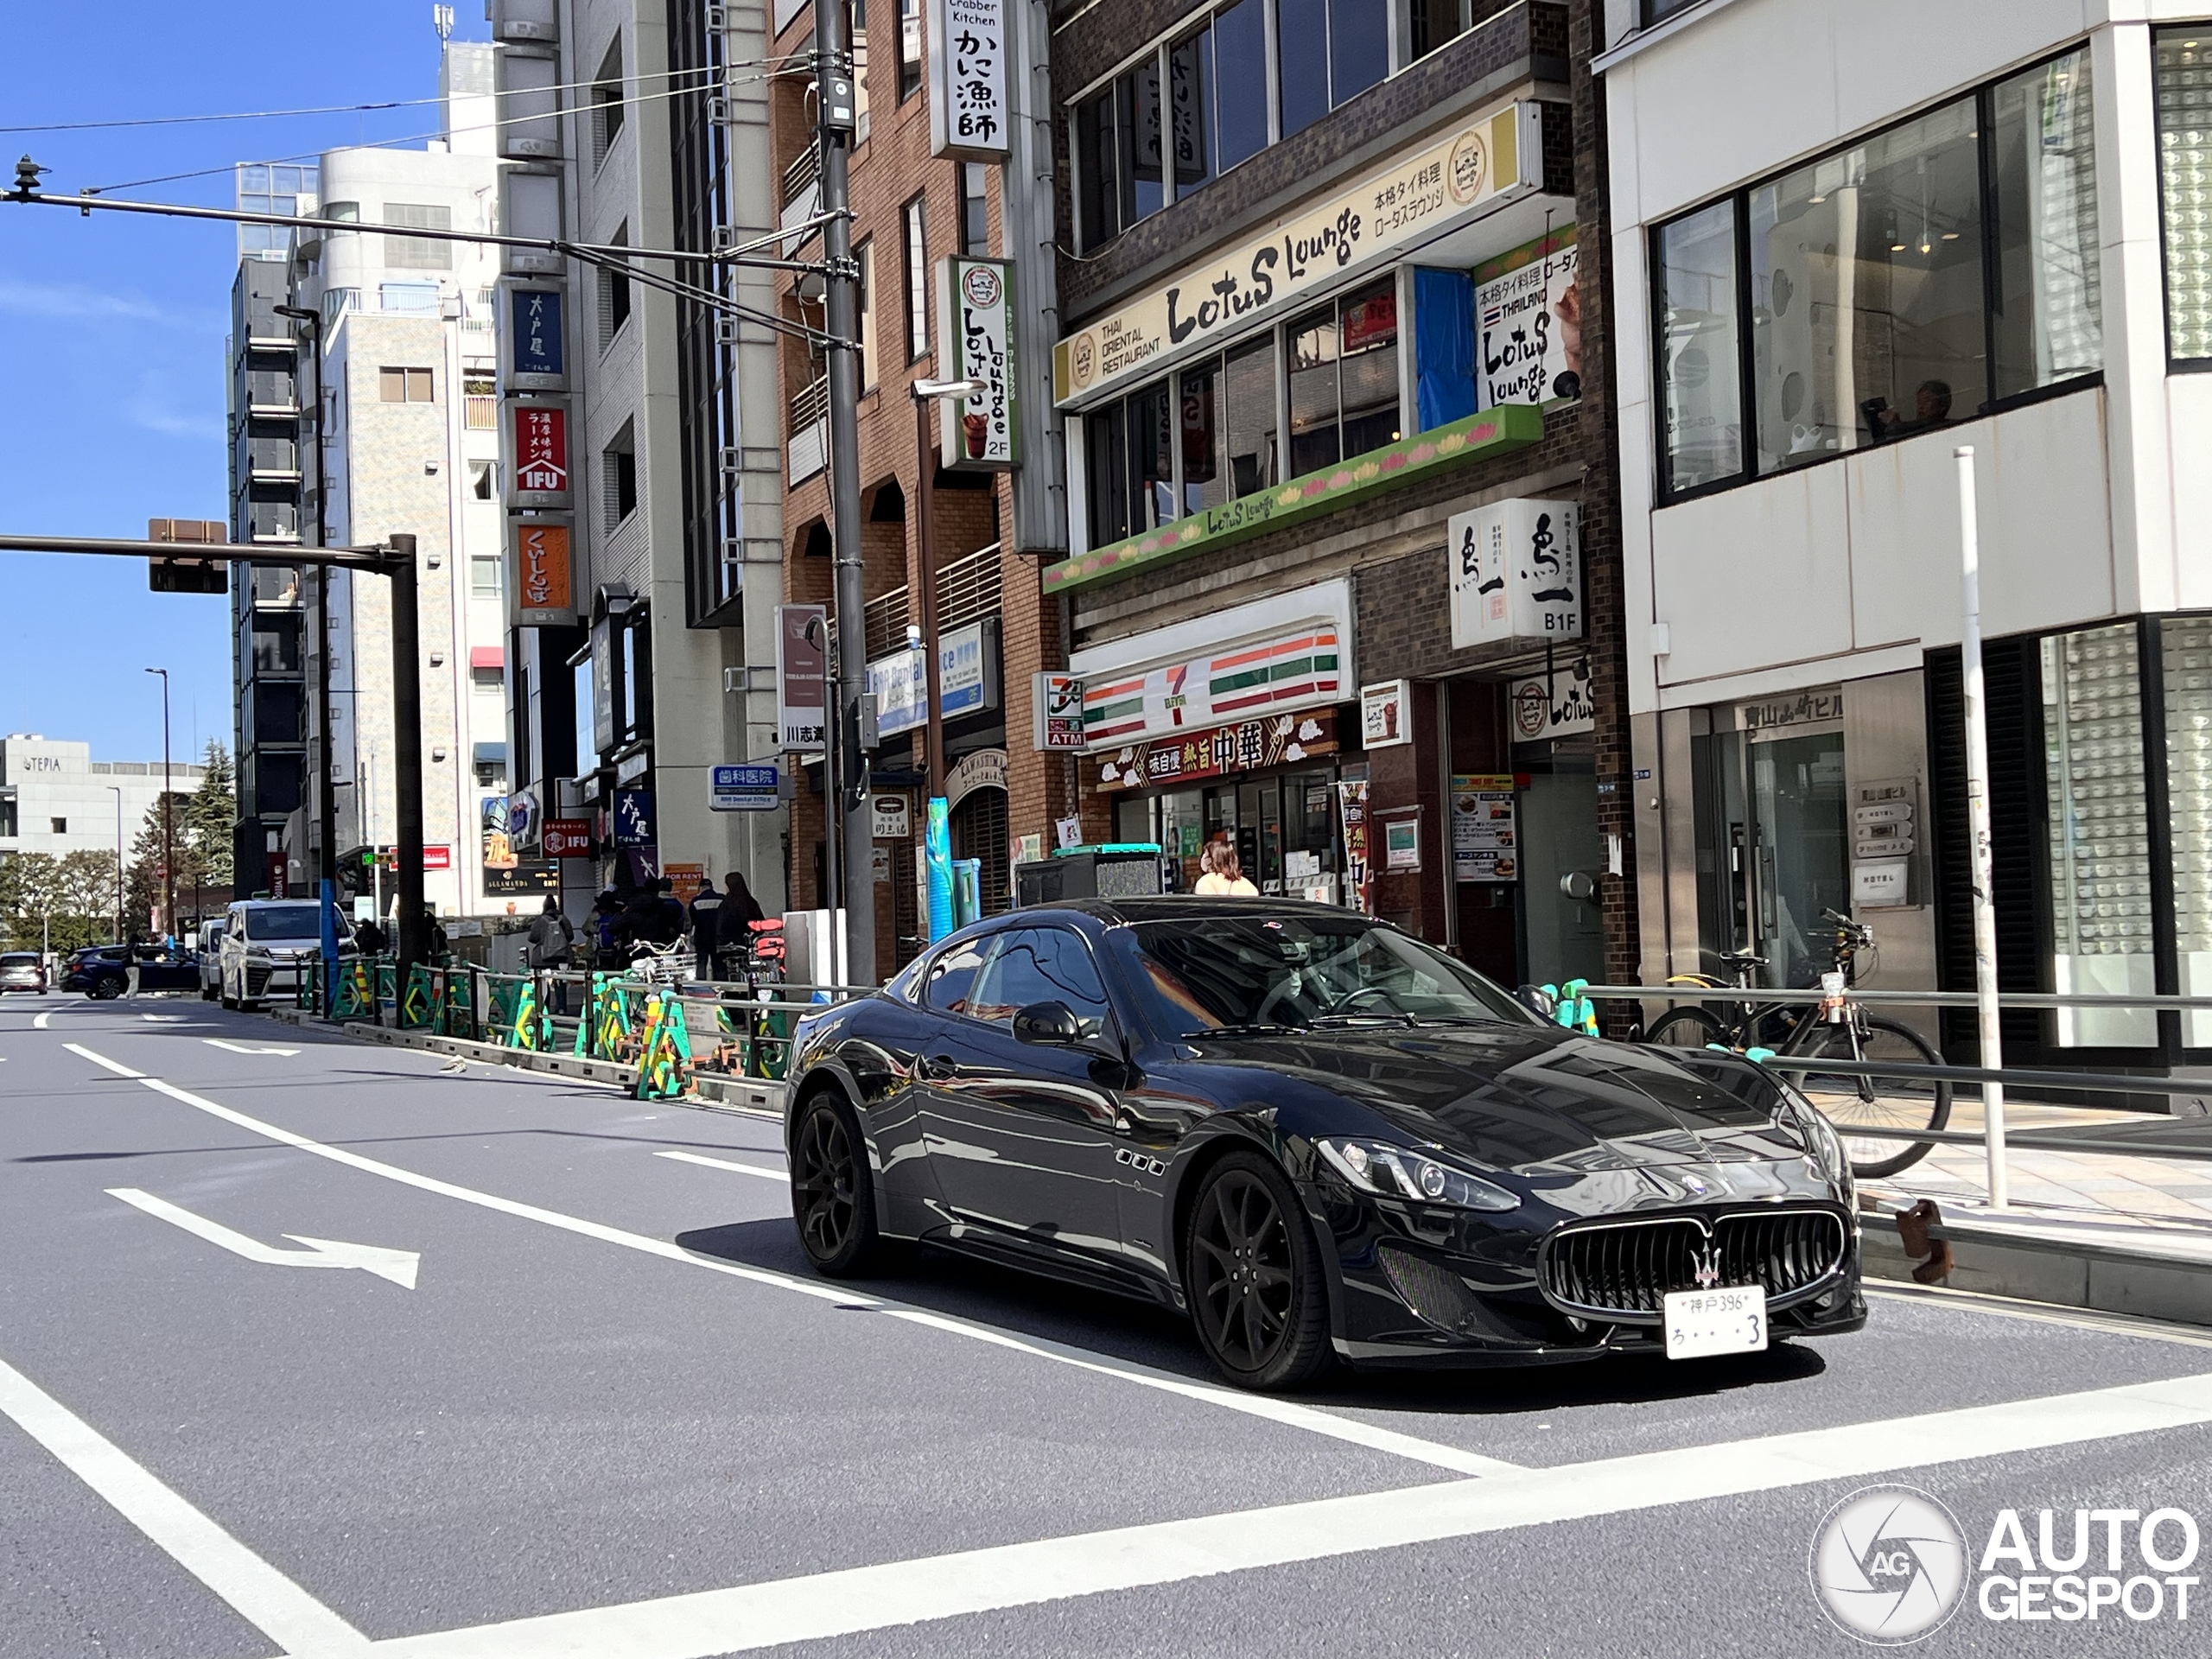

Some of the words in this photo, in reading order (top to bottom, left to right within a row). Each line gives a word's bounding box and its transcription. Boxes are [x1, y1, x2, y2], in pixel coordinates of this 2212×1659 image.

[952, 11, 996, 27] Kitchen
[953, 29, 998, 143] かに漁師
[1374, 161, 1441, 212] 本格タイ料理
[1375, 184, 1445, 238] ロータスラウンジ
[1285, 207, 1361, 281] Lounge
[1478, 264, 1541, 307] 本格タイ料理
[1501, 288, 1547, 319] THAILAND
[529, 295, 546, 356] 大戸屋
[1102, 318, 1122, 337] THAI
[1102, 327, 1143, 358] ORIENTAL
[1102, 337, 1160, 377] RESTAURANT
[529, 412, 540, 460] ラーメン
[539, 412, 552, 460] 濃厚味噌
[988, 442, 1008, 455] 2F
[526, 471, 558, 490] IFU
[526, 530, 553, 604] くいしんぼ
[1544, 612, 1576, 631] B1F
[1052, 734, 1082, 745] ATM
[1148, 750, 1181, 774] 味自慢
[1182, 738, 1211, 773] 熱旨
[1211, 722, 1264, 775] 中華
[31, 757, 61, 772] TEPIA
[718, 769, 773, 785] 歯科医院
[621, 793, 650, 836] 大戸屋
[568, 836, 588, 848] IFU
